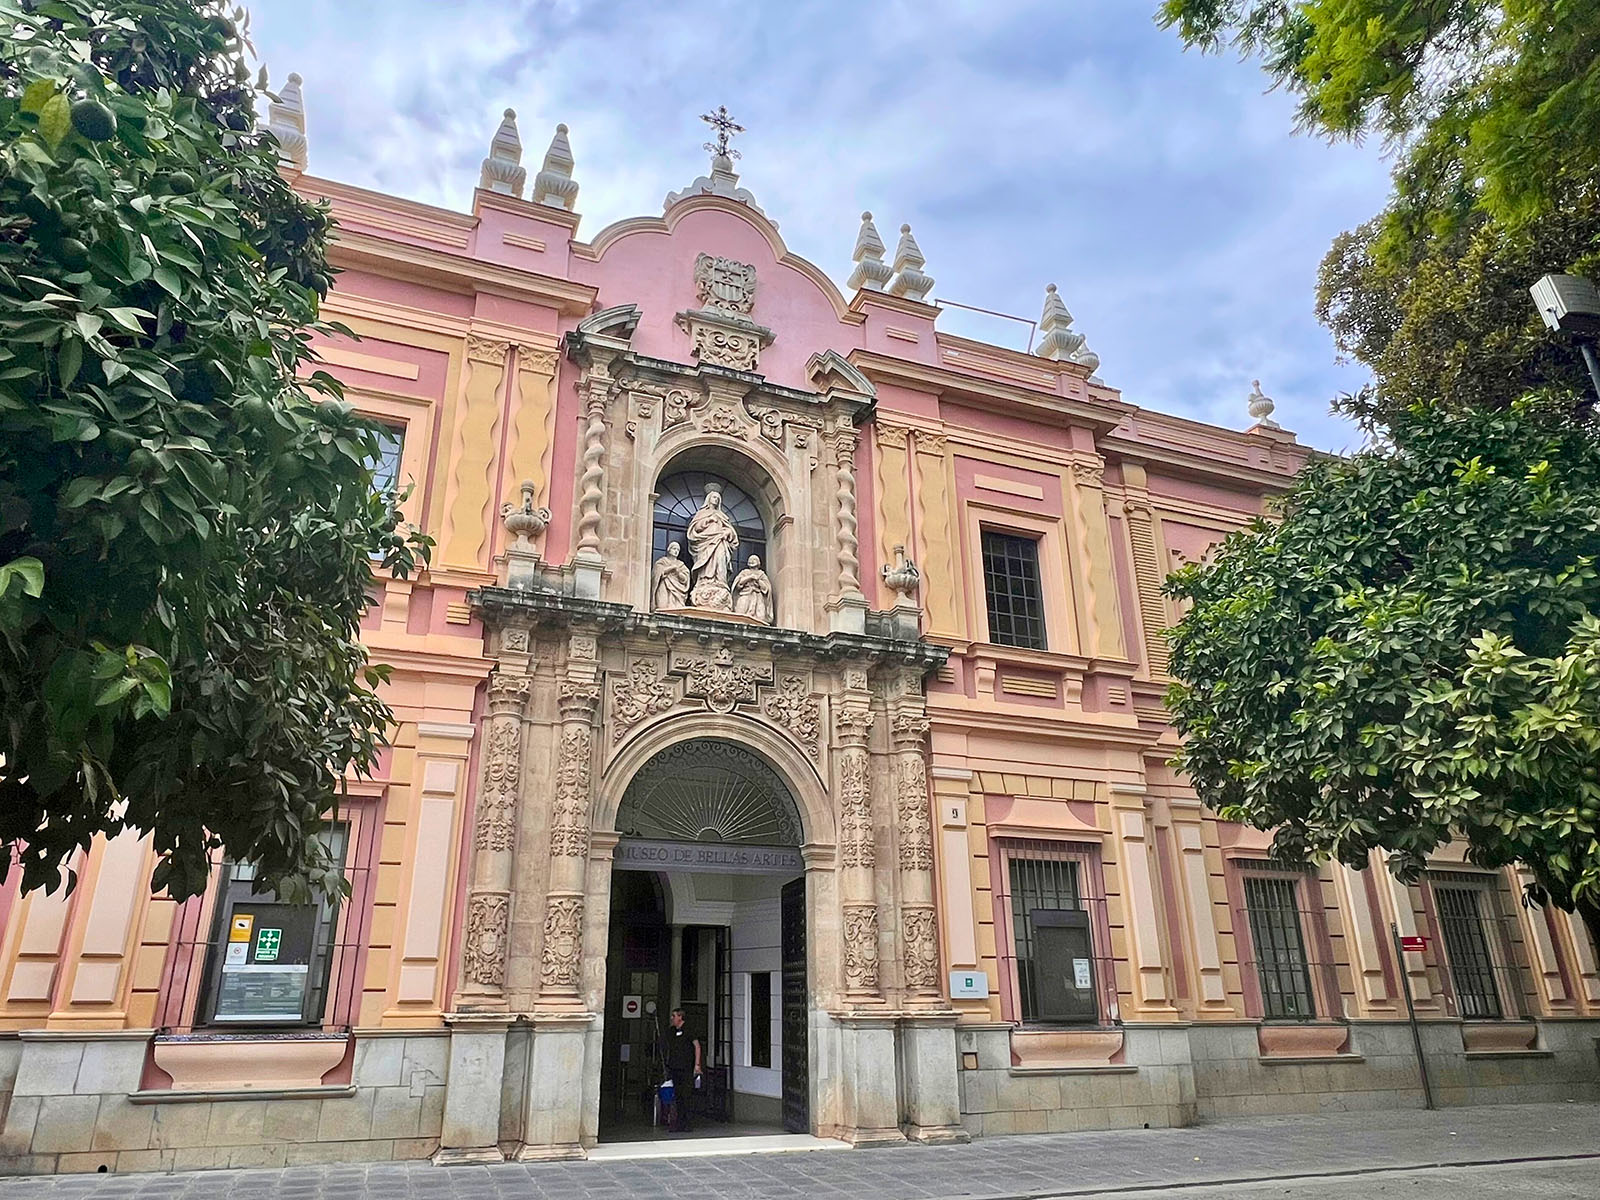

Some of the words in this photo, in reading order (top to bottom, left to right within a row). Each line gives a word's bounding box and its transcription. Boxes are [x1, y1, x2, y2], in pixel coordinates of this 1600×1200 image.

[952, 808, 958, 819] 9
[673, 848, 693, 863] DE
[695, 849, 749, 864] BELLAS
[751, 854, 798, 867] ARTES
